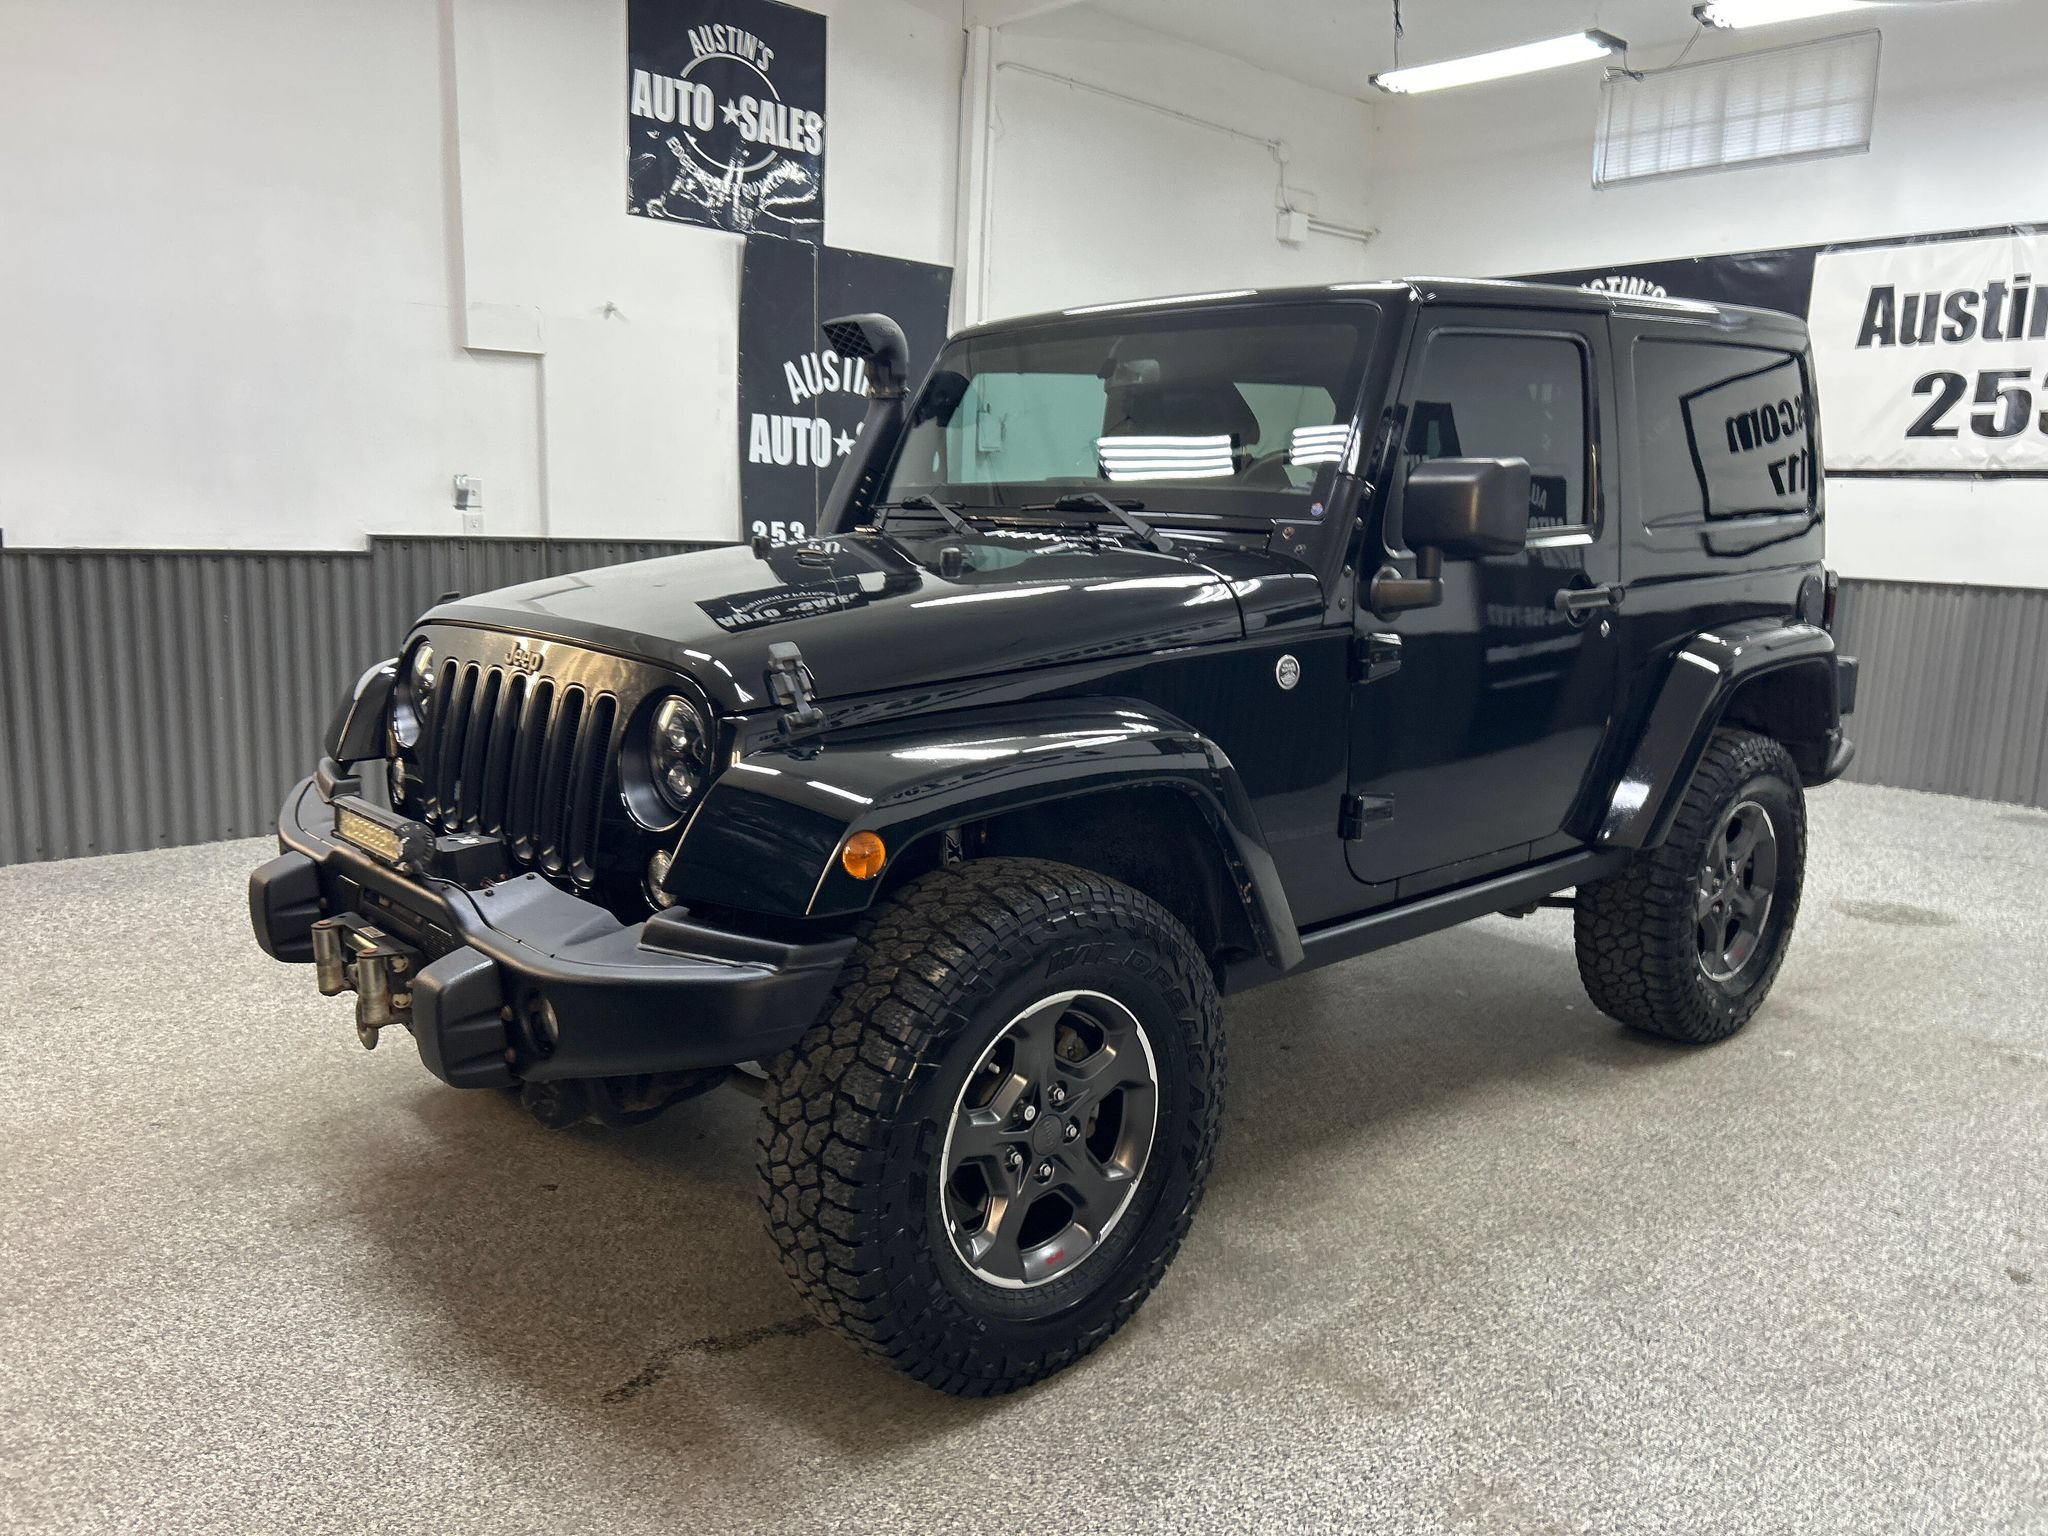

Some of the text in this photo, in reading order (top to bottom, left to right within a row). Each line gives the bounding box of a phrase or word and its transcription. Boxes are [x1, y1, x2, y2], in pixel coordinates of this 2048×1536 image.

[687, 23, 775, 73] AUSTIN'S
[631, 68, 824, 156] AUTO SALES
[1904, 366, 2048, 440] 25
[748, 412, 832, 468] AUTO
[505, 641, 545, 675] Jeep
